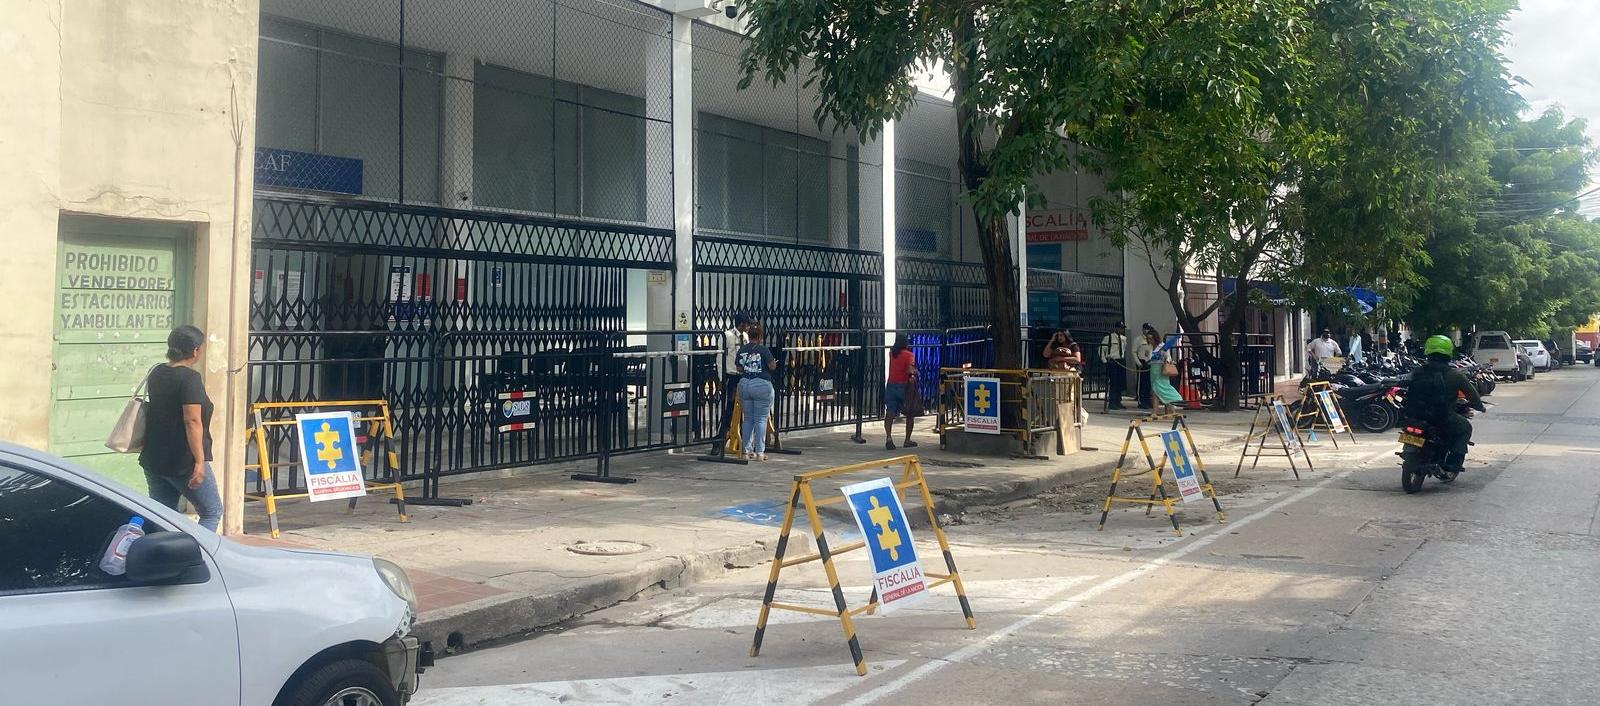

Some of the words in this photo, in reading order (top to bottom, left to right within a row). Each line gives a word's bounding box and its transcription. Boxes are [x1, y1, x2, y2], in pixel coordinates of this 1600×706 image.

[65, 252, 158, 272] PROHIBIDO
[68, 275, 172, 290] VENDEDORES
[61, 293, 174, 310] ESTACIONARIOS
